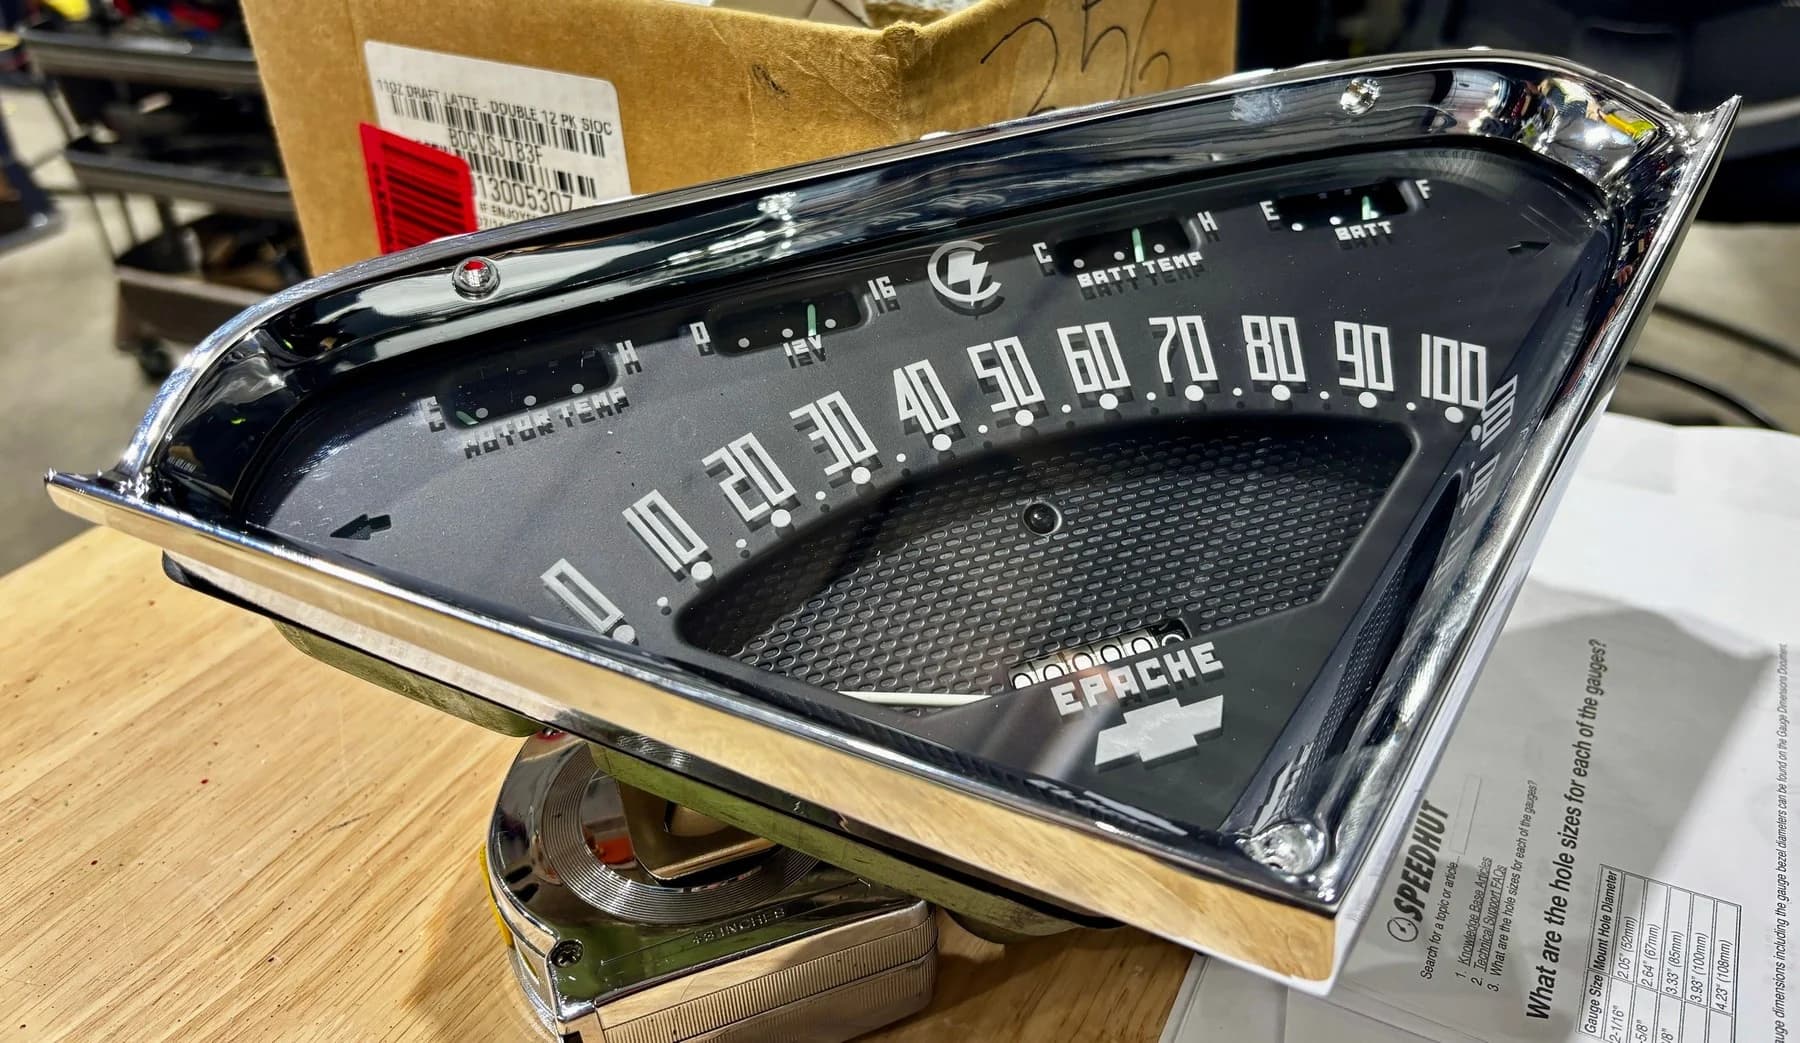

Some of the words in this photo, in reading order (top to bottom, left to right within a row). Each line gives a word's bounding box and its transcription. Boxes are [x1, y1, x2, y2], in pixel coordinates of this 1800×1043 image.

[406, 85, 440, 103] DRAFT
[444, 93, 480, 110] LATTE
[489, 100, 538, 121] DOUBLE
[541, 109, 558, 125] 12
[561, 113, 578, 129] PK
[581, 117, 613, 136] SIOC
[473, 175, 573, 213] 13005307
[1415, 179, 1433, 199] F
[1197, 211, 1220, 232] H
[1258, 200, 1281, 222] E
[1334, 221, 1393, 242] BATT
[1032, 242, 1053, 265] C
[1076, 264, 1137, 288] BATT
[1142, 251, 1203, 275] TEMP
[867, 275, 897, 300] 16
[616, 340, 640, 364] H
[783, 334, 823, 357] 12V
[461, 411, 552, 454] MOTOR
[558, 386, 628, 420] TEMP
[540, 558, 624, 634] 0
[622, 489, 709, 572] 10
[701, 432, 798, 522] 20
[789, 391, 879, 477] 30
[893, 359, 962, 434] 40
[966, 336, 1045, 413] 50
[1057, 321, 1131, 394] 60
[1148, 315, 1218, 383] 70
[1241, 315, 1306, 383] 80
[1334, 320, 1394, 392] 90
[1421, 333, 1488, 409] 100
[1051, 641, 1224, 716] EPACHE
[1586, 639, 1608, 696] gauges?
[1577, 697, 1598, 720] the
[1576, 720, 1594, 738] of
[1776, 714, 1790, 737] Gauge
[1777, 738, 1788, 750] the
[1778, 750, 1787, 761] on
[1572, 741, 1592, 777] each
[1776, 760, 1788, 783] found
[1563, 779, 1586, 804] for
[1776, 783, 1787, 794] be
[1778, 794, 1787, 809] can
[1518, 815, 1532, 829] the
[1518, 828, 1529, 839] of
[1557, 806, 1582, 850] sizes
[1776, 810, 1787, 849] diameters
[1393, 799, 1448, 923] SPEEDHUT
[1515, 838, 1527, 859] each
[1775, 848, 1787, 873] bezel
[1474, 857, 1492, 891] Articles
[1489, 864, 1507, 892] FAQs
[1510, 859, 1523, 872] for
[1548, 853, 1575, 892] hole
[1442, 888, 1452, 899] or
[1506, 872, 1521, 896] sizes
[1601, 870, 1619, 913] Diameter
[1777, 873, 1790, 902] gauge
[1434, 899, 1450, 922] topic
[1469, 889, 1486, 915] Base
[1483, 890, 1502, 927] Support
[1501, 896, 1516, 917] hole
[1544, 895, 1568, 926] the
[1774, 902, 1786, 917] the
[1428, 930, 1442, 944] for
[1434, 922, 1444, 930] a
[1498, 917, 1512, 933] the
[1597, 914, 1612, 938] Hole
[1621, 916, 1638, 953] (52mm)
[1457, 914, 1481, 967] Knowledge
[1473, 926, 1495, 972] Technical
[1498, 934, 1509, 950] are
[1542, 930, 1562, 963] are
[1645, 923, 1661, 960] (67mm)
[1668, 930, 1685, 967] (85mm)
[1773, 918, 1790, 961] including
[1420, 945, 1439, 980] Search
[1489, 951, 1506, 976] What
[1593, 938, 1608, 971] Mount
[1617, 953, 1631, 979] 2.05"
[1692, 932, 1709, 975] (100mm)
[1717, 939, 1734, 983] (108mm)
[1588, 974, 1606, 997] Size
[1642, 960, 1655, 987] 2.64"
[1666, 967, 1679, 995] 3.33"
[1487, 983, 1500, 992] 3.
[1526, 965, 1557, 1020] What
[1690, 975, 1704, 1003] 3.93"
[1715, 984, 1729, 1010] 4.23"
[1772, 961, 1786, 1018] dimensions
[1584, 997, 1602, 1033] Gauge
[1634, 1019, 1648, 1043] -5/8"
[1774, 1020, 1789, 1043] auge
